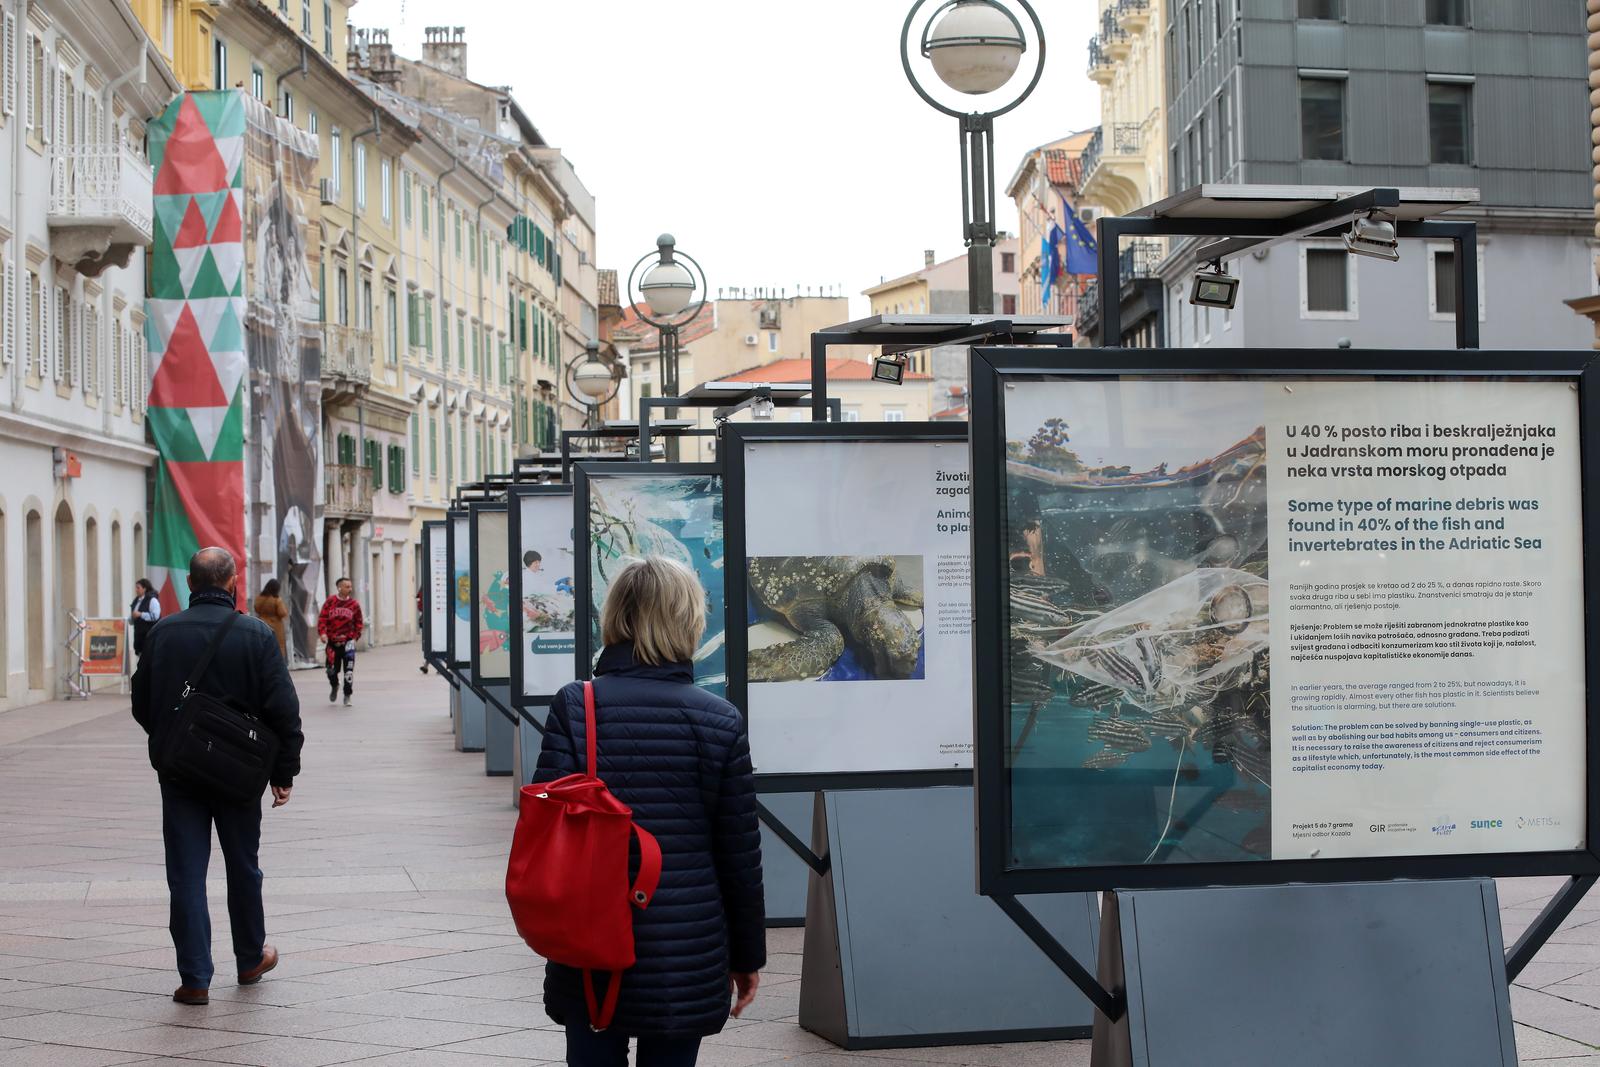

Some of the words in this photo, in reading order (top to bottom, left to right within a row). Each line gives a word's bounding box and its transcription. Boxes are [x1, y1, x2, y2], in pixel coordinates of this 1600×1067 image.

[1286, 426, 1296, 437] U
[1301, 425, 1320, 437] 40
[1324, 425, 1338, 437] %
[1341, 425, 1386, 441] posto
[1390, 423, 1421, 437] riba
[1425, 424, 1429, 437] i
[1433, 423, 1555, 441] beskralježnjaka
[1287, 447, 1296, 457] u
[1301, 444, 1402, 457] Jadranskom
[1406, 447, 1448, 457] moru
[1452, 444, 1538, 460] pronađena
[1541, 443, 1554, 460] je
[1287, 464, 1327, 477] neka
[1331, 465, 1372, 476] vrsta
[1377, 463, 1446, 480] morskog
[1450, 463, 1506, 480] otpada
[1288, 499, 1333, 512] Some
[1337, 499, 1373, 515] type
[1376, 498, 1392, 511] of
[1395, 498, 1452, 511] marine
[1455, 497, 1504, 510] debris
[1508, 500, 1538, 510] was
[937, 524, 948, 532] to
[951, 523, 970, 534] pla
[1288, 518, 1335, 532] found
[1339, 518, 1353, 531] in
[1357, 518, 1391, 531] 40%
[1394, 517, 1409, 530] of
[1412, 517, 1438, 530] the
[1442, 517, 1470, 530] fish
[1474, 517, 1504, 529] and
[1289, 537, 1397, 551] invertebrates
[1401, 536, 1415, 550] in
[1419, 537, 1445, 550] the
[1449, 536, 1510, 549] Adriatic
[1514, 536, 1541, 549] Sea
[1384, 622, 1406, 630] riješiti
[1444, 620, 1487, 629] jednokratne
[1294, 633, 1332, 642] ukidanjem
[1502, 629, 1529, 638] podizati
[1291, 643, 1313, 652] svijest
[1314, 643, 1346, 652] građana
[1291, 654, 1323, 662] najčešća
[1324, 652, 1362, 661] nuspojava
[1363, 652, 1411, 660] kapitalističke
[1412, 651, 1449, 659] ekonomije
[1338, 723, 1369, 731] problem
[1429, 721, 1458, 729] banning
[1459, 720, 1497, 728] single-use
[1328, 733, 1366, 742] abolishing
[1308, 754, 1336, 762] lifestyle
[1292, 764, 1326, 773] capitalist
[1470, 820, 1502, 829] sunce
